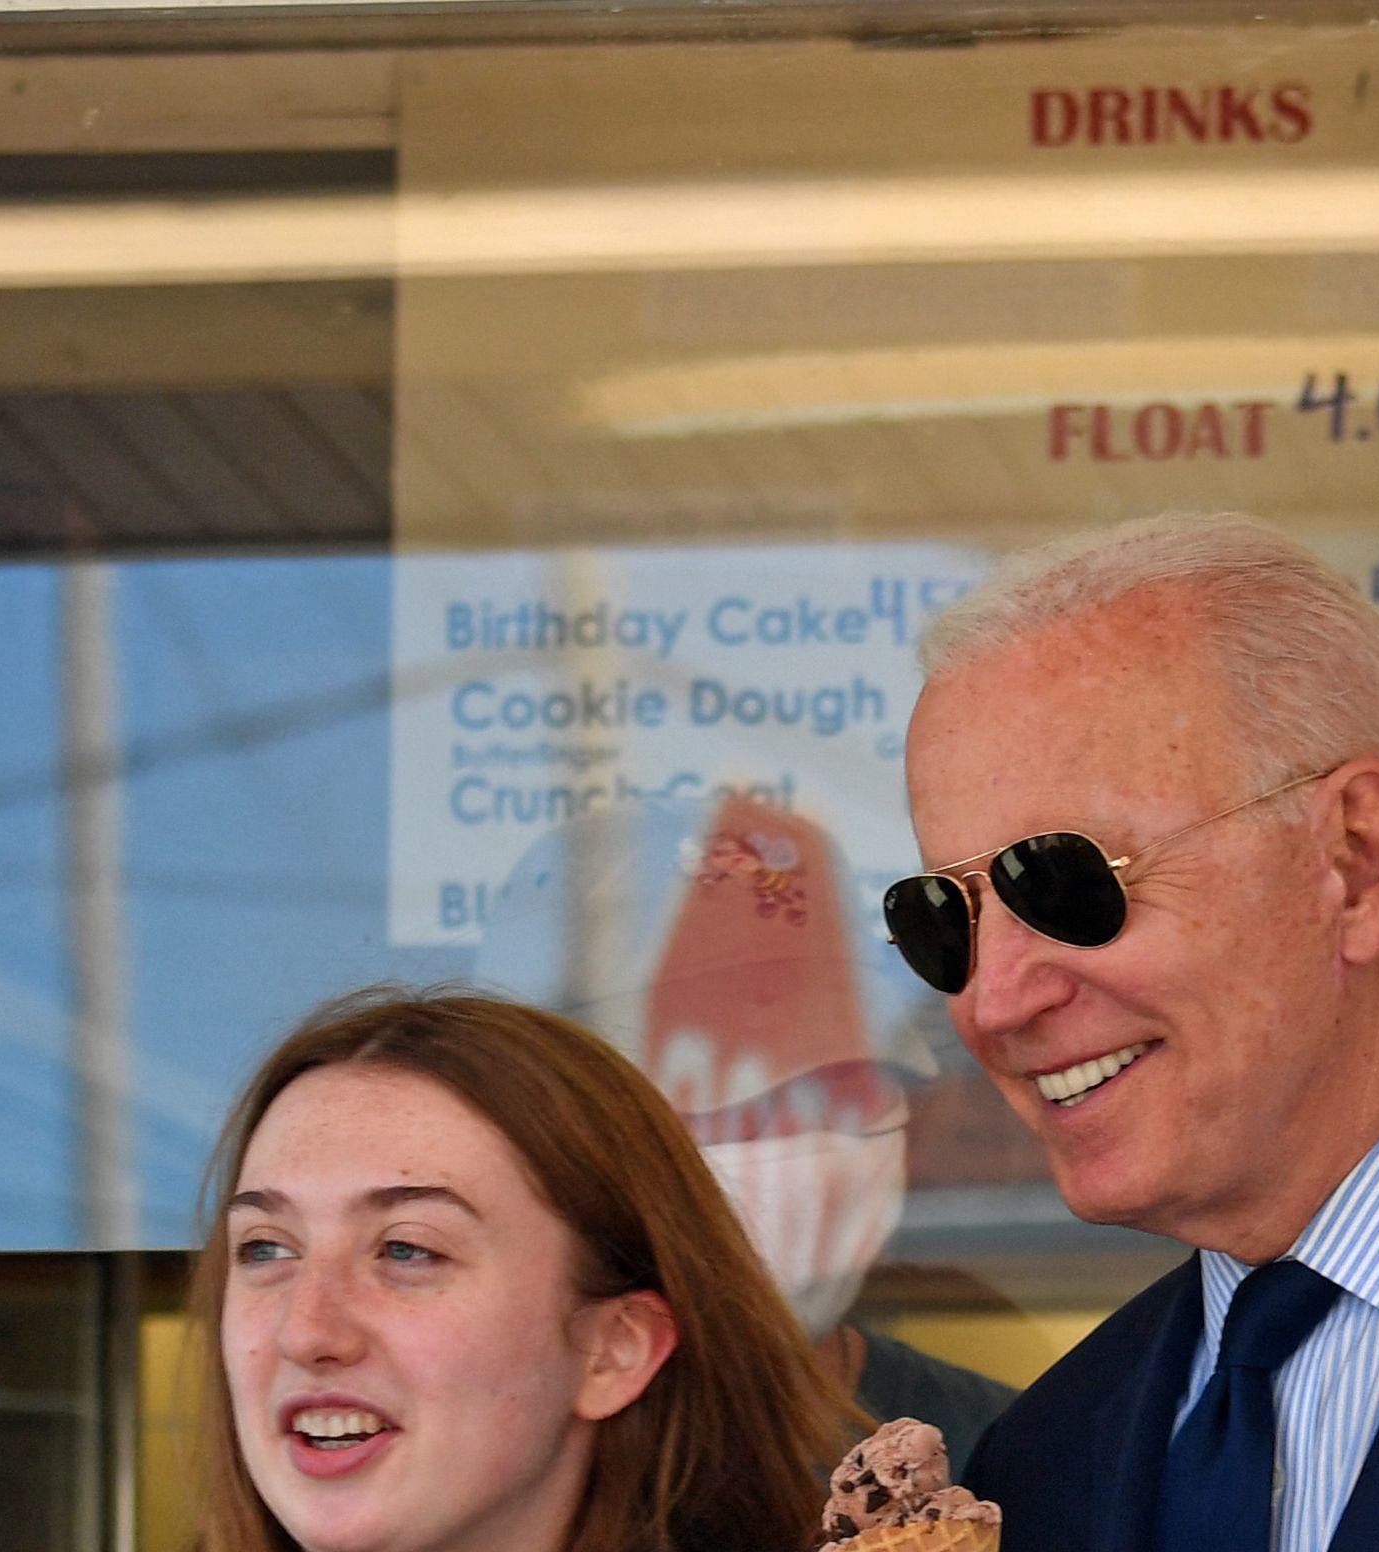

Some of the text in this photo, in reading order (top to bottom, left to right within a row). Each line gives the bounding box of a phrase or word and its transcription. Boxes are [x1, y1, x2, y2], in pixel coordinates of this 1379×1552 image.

[1029, 79, 1314, 148] DRINKS
[1046, 400, 1275, 463] FLOAT
[445, 595, 869, 659] Birthday Cake
[450, 674, 887, 736] Cookie Dough
